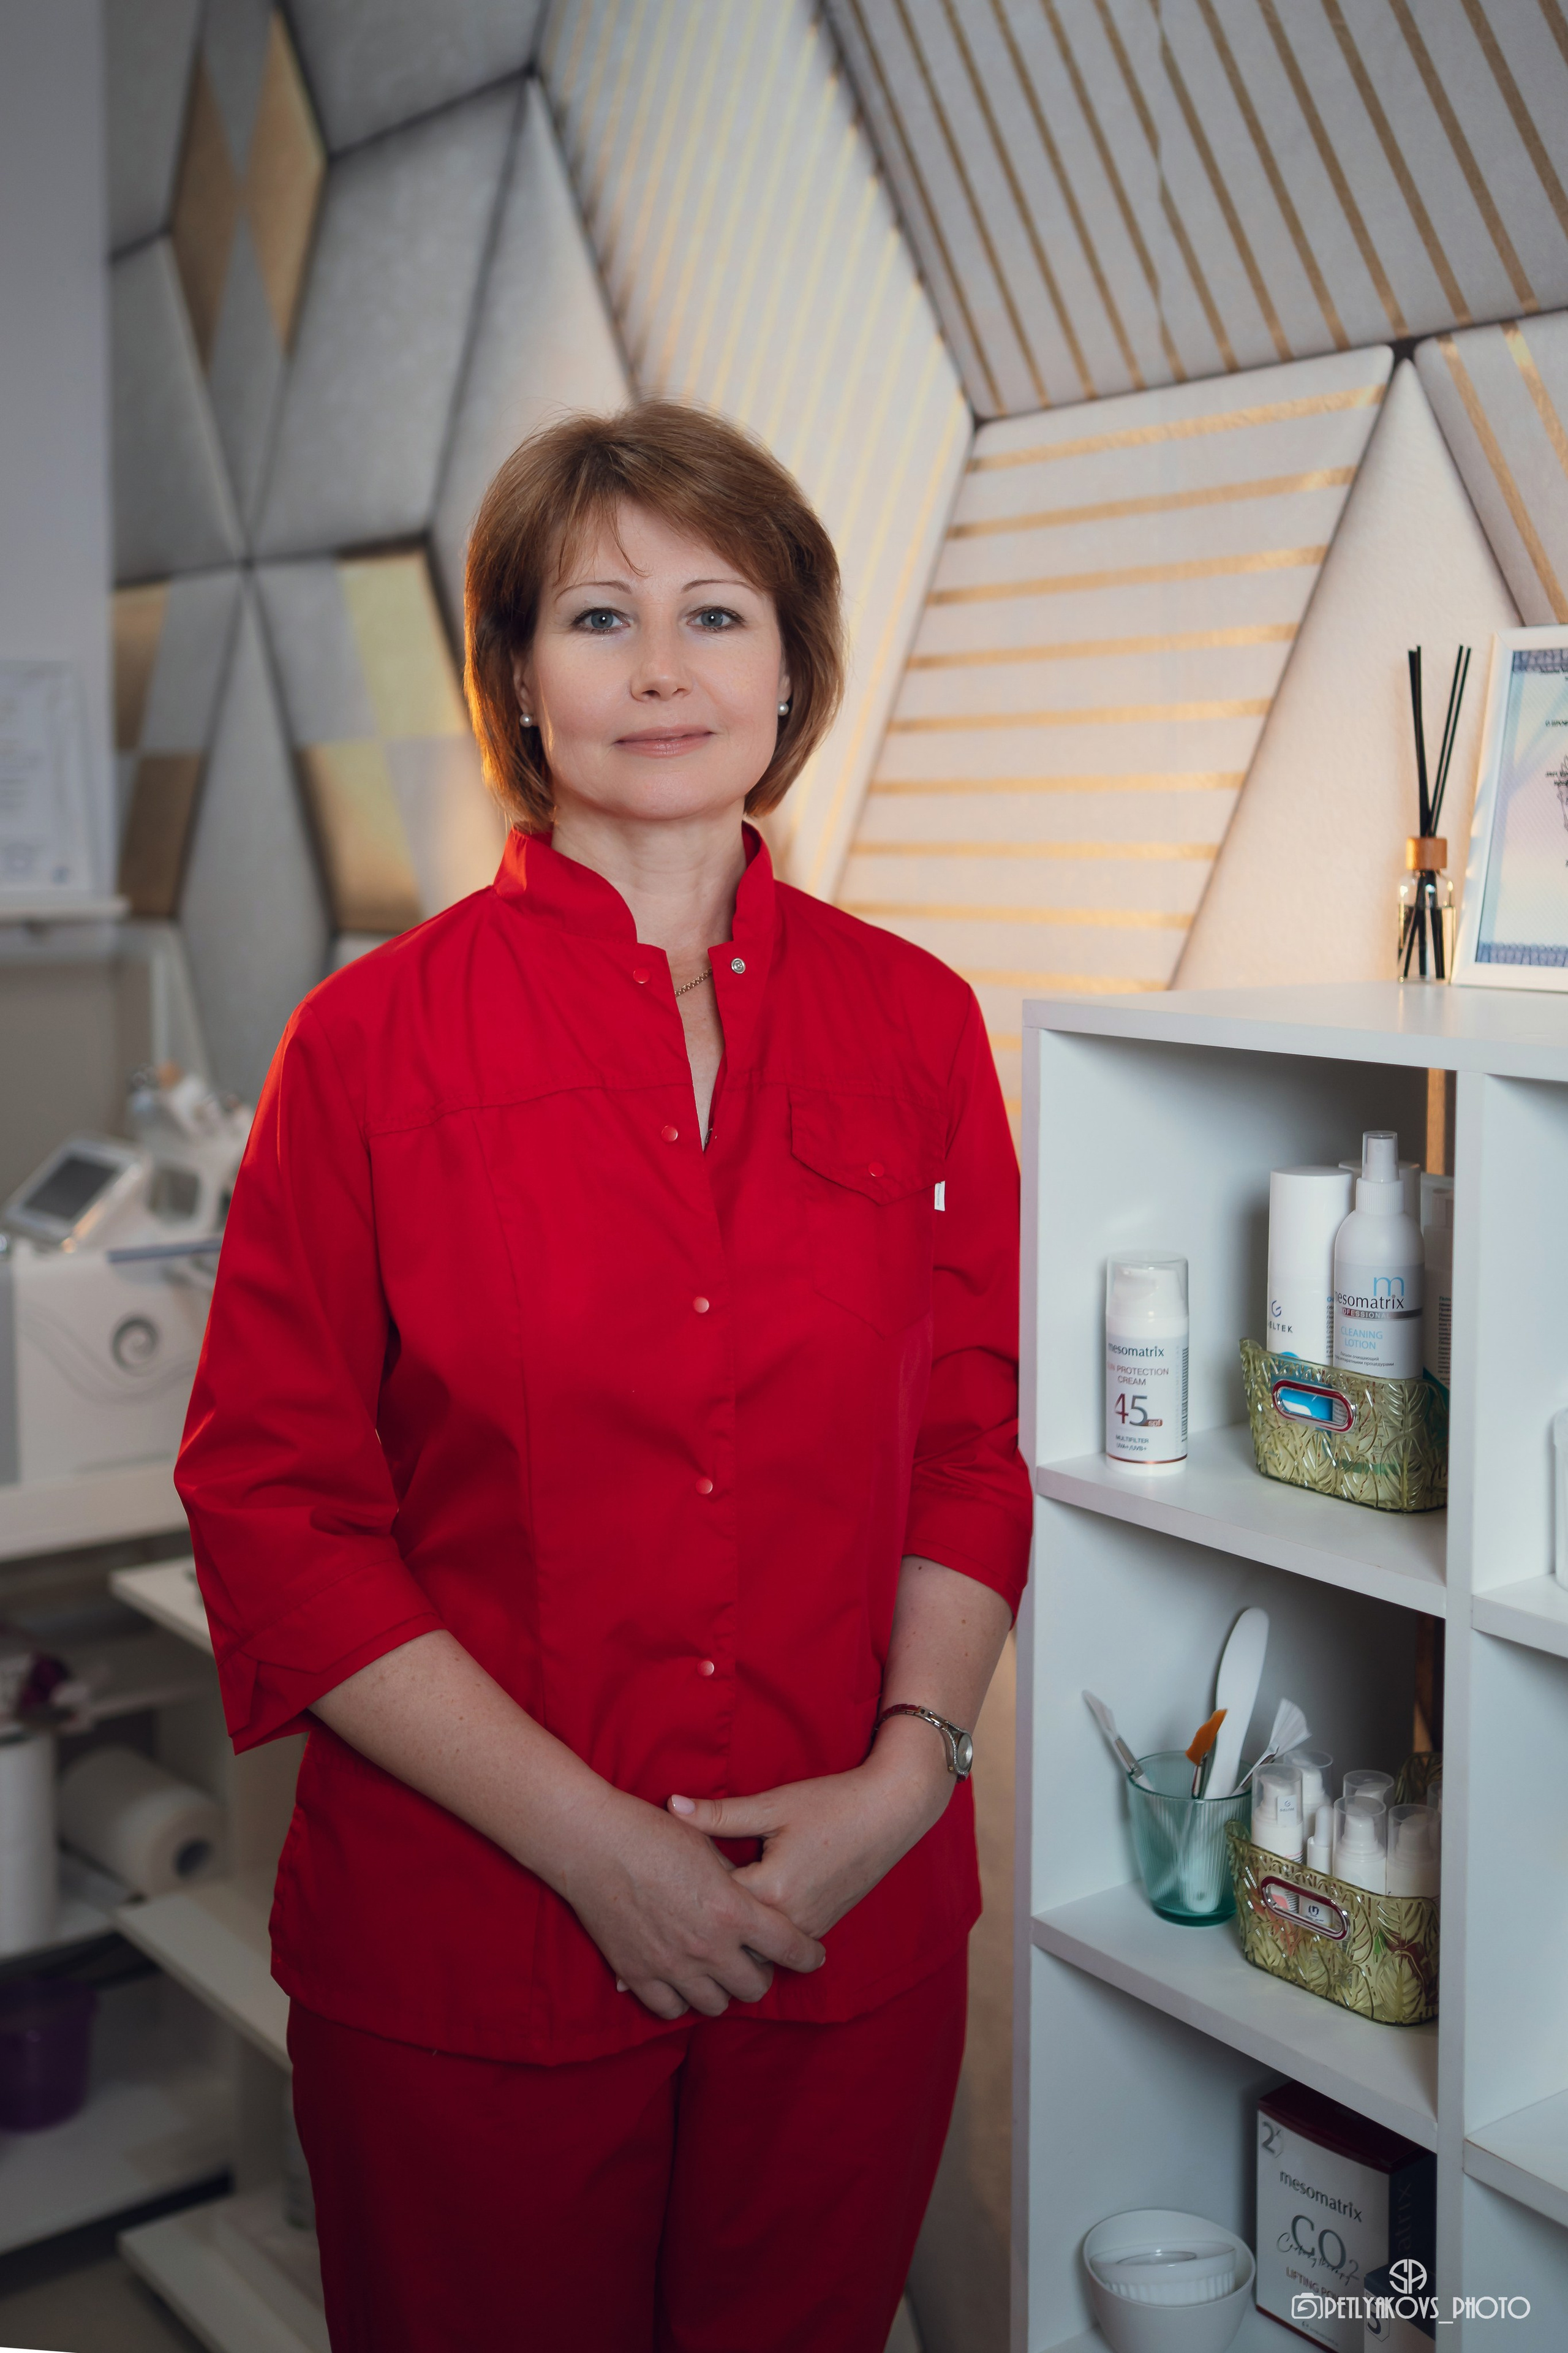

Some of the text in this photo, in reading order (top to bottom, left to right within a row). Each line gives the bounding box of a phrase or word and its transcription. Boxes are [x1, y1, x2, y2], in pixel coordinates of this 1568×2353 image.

[1343, 1307, 1390, 1318] OFESSIONAL
[1267, 1320, 1293, 1334] ELTEK
[1341, 1326, 1383, 1339] CLEANING
[1108, 1343, 1164, 1357] mesomatrix
[1344, 1338, 1376, 1350] LOTION
[1117, 1365, 1169, 1376] PROTECTION
[1117, 1375, 1147, 1386] CREAM
[1114, 1392, 1148, 1426] 45
[1115, 1434, 1150, 1443] MULTIFILTER
[1280, 2170, 1363, 2223] mesomatrix
